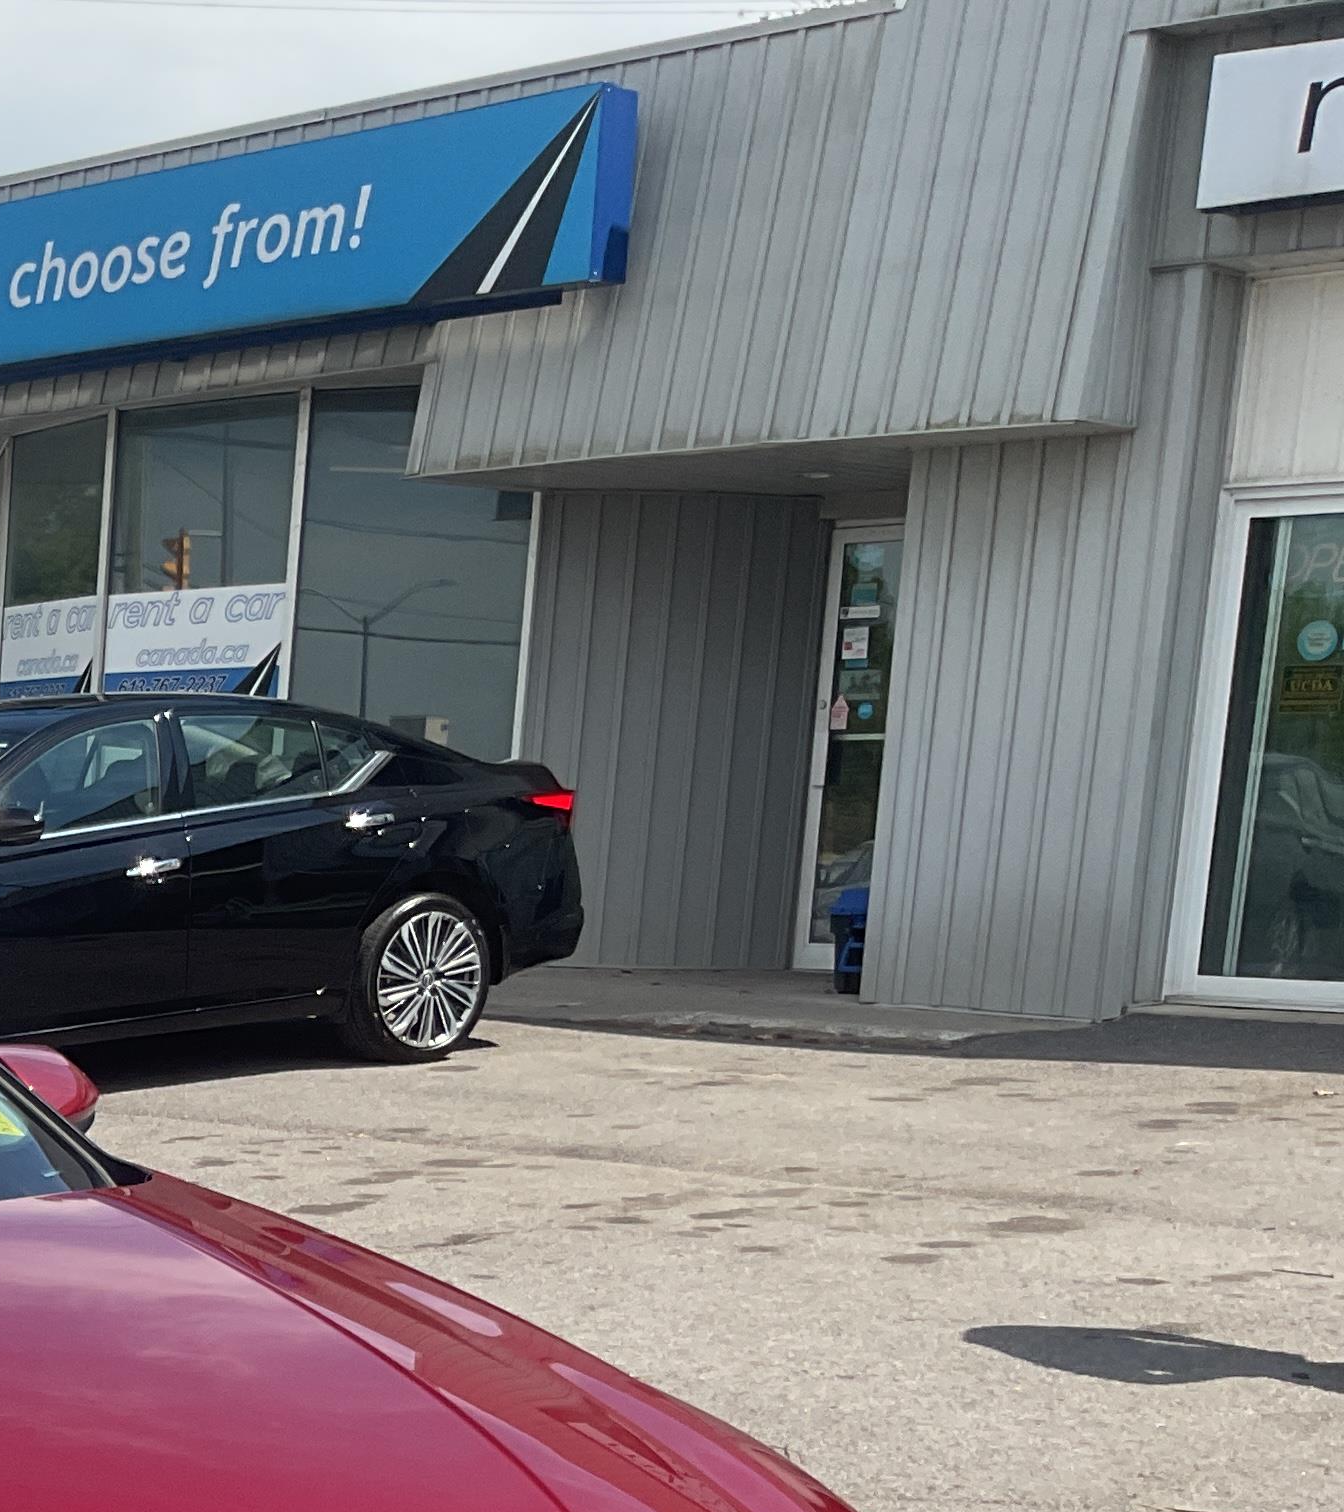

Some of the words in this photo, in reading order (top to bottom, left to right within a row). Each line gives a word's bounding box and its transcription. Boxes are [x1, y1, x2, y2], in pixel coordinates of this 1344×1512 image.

[9, 228, 192, 307] choose
[202, 184, 374, 289] from!
[3, 605, 43, 640] rent
[47, 609, 61, 635] a
[66, 604, 97, 633] car
[107, 591, 181, 629] rent
[189, 597, 214, 625] a
[225, 591, 286, 623] car
[136, 638, 250, 667] canada.ca
